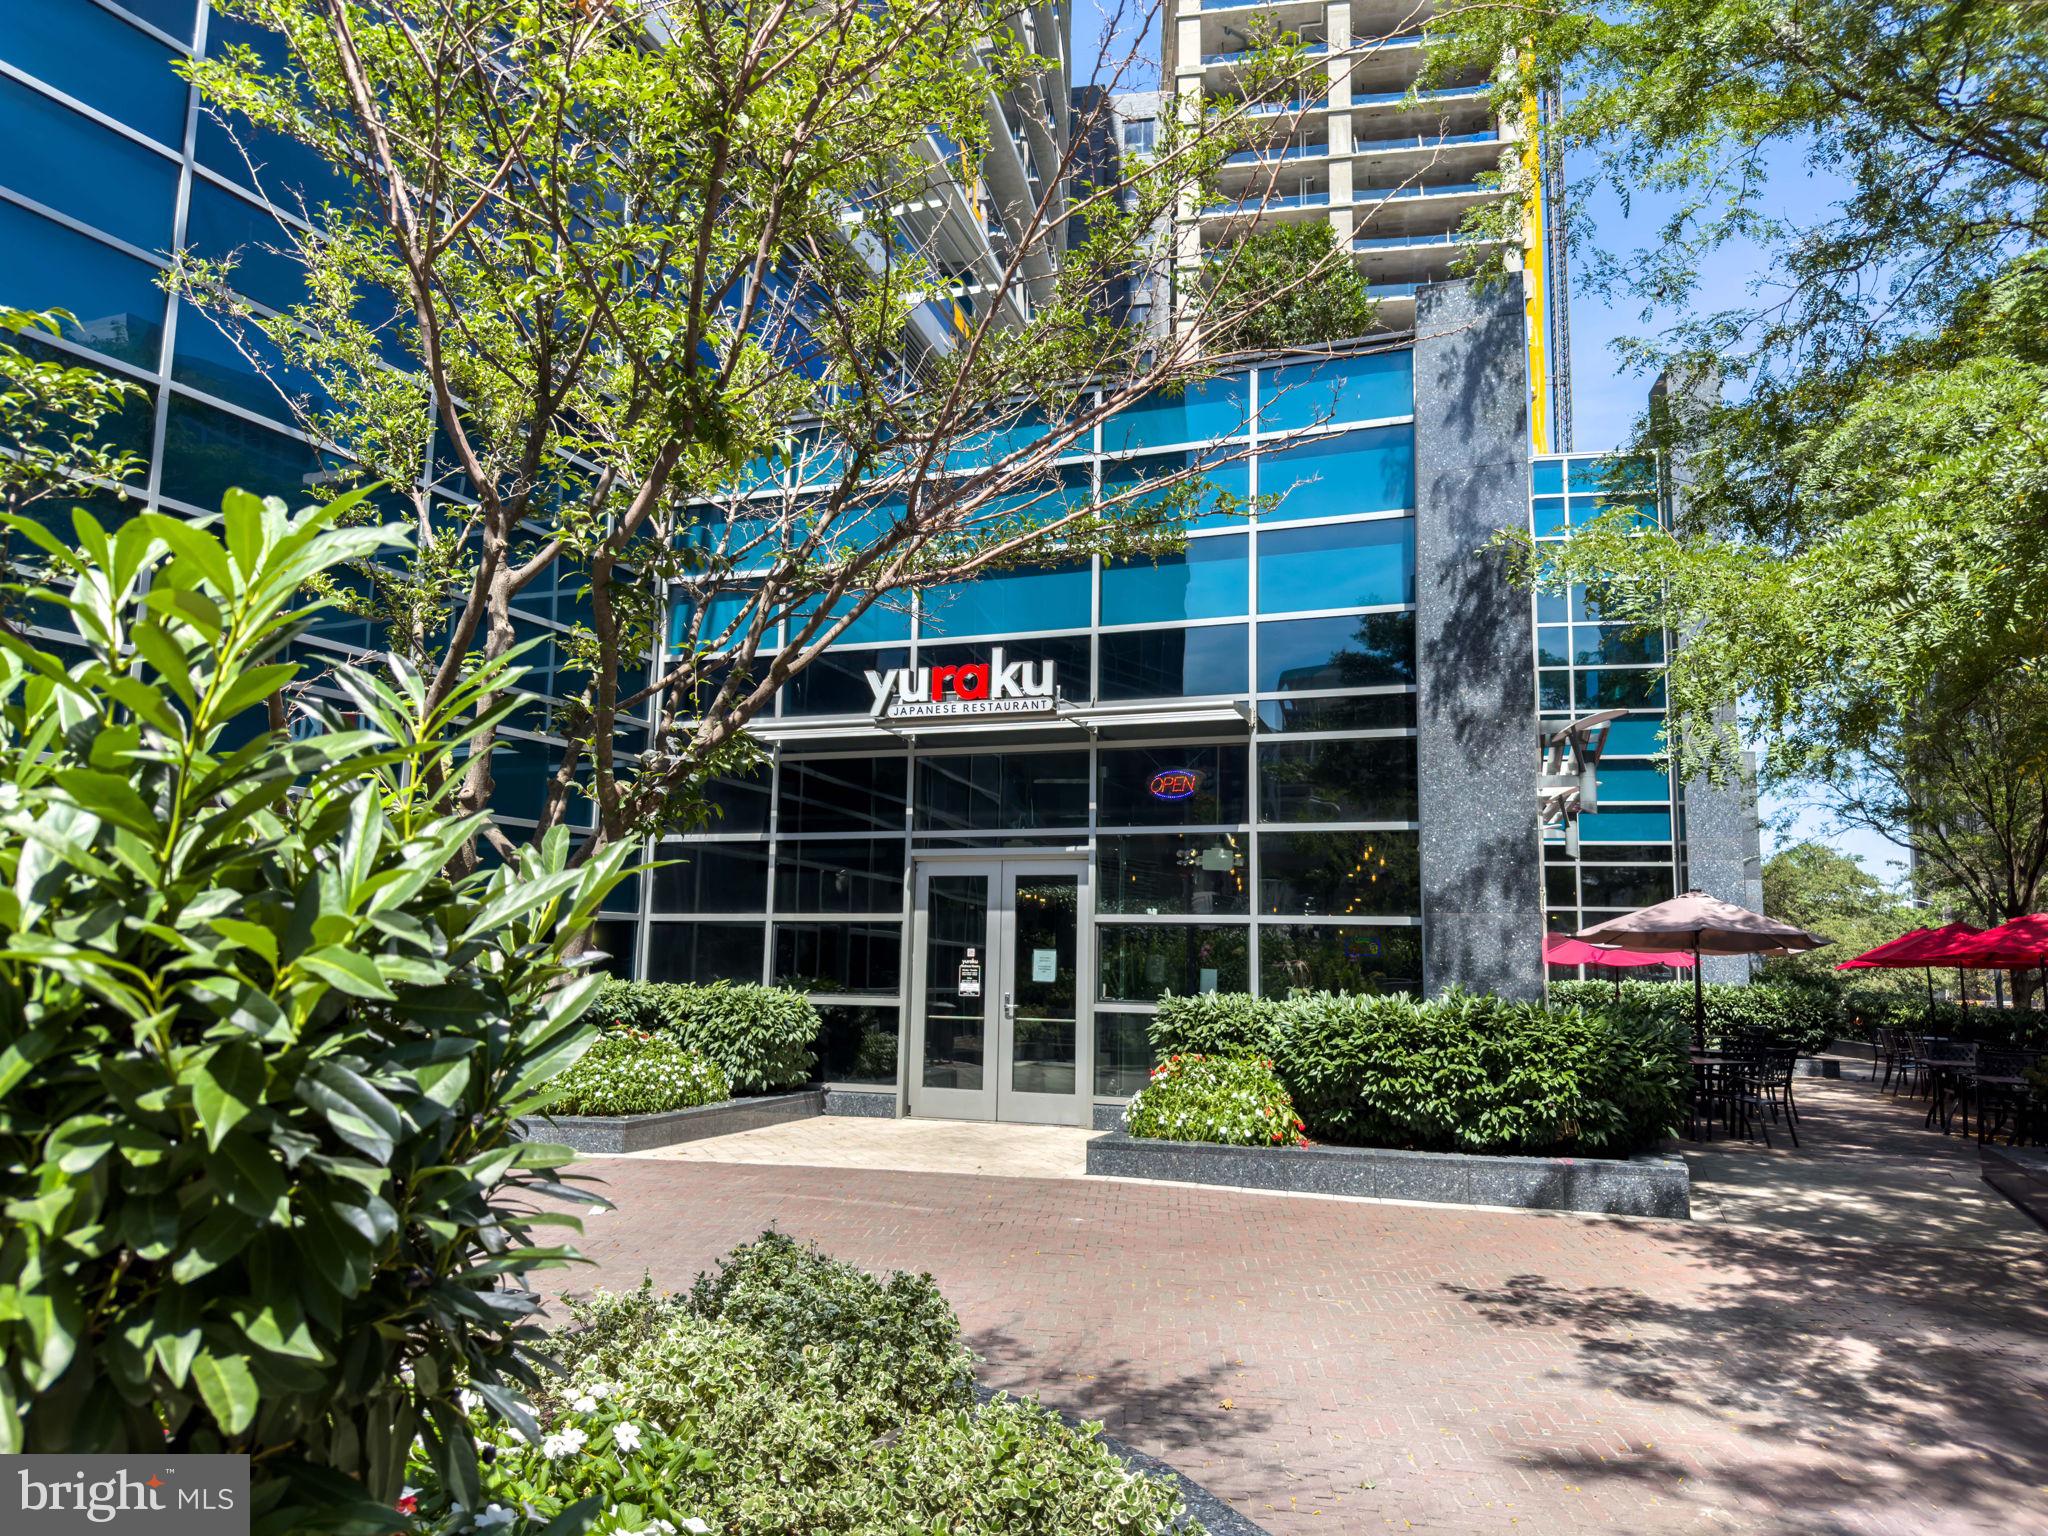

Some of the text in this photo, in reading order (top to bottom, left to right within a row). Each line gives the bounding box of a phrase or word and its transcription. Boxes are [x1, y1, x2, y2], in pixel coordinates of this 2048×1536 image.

[864, 647, 1057, 718] yuraku
[893, 700, 1047, 716] JAPANESE RESTAURANT
[1151, 776, 1196, 793] OPEN
